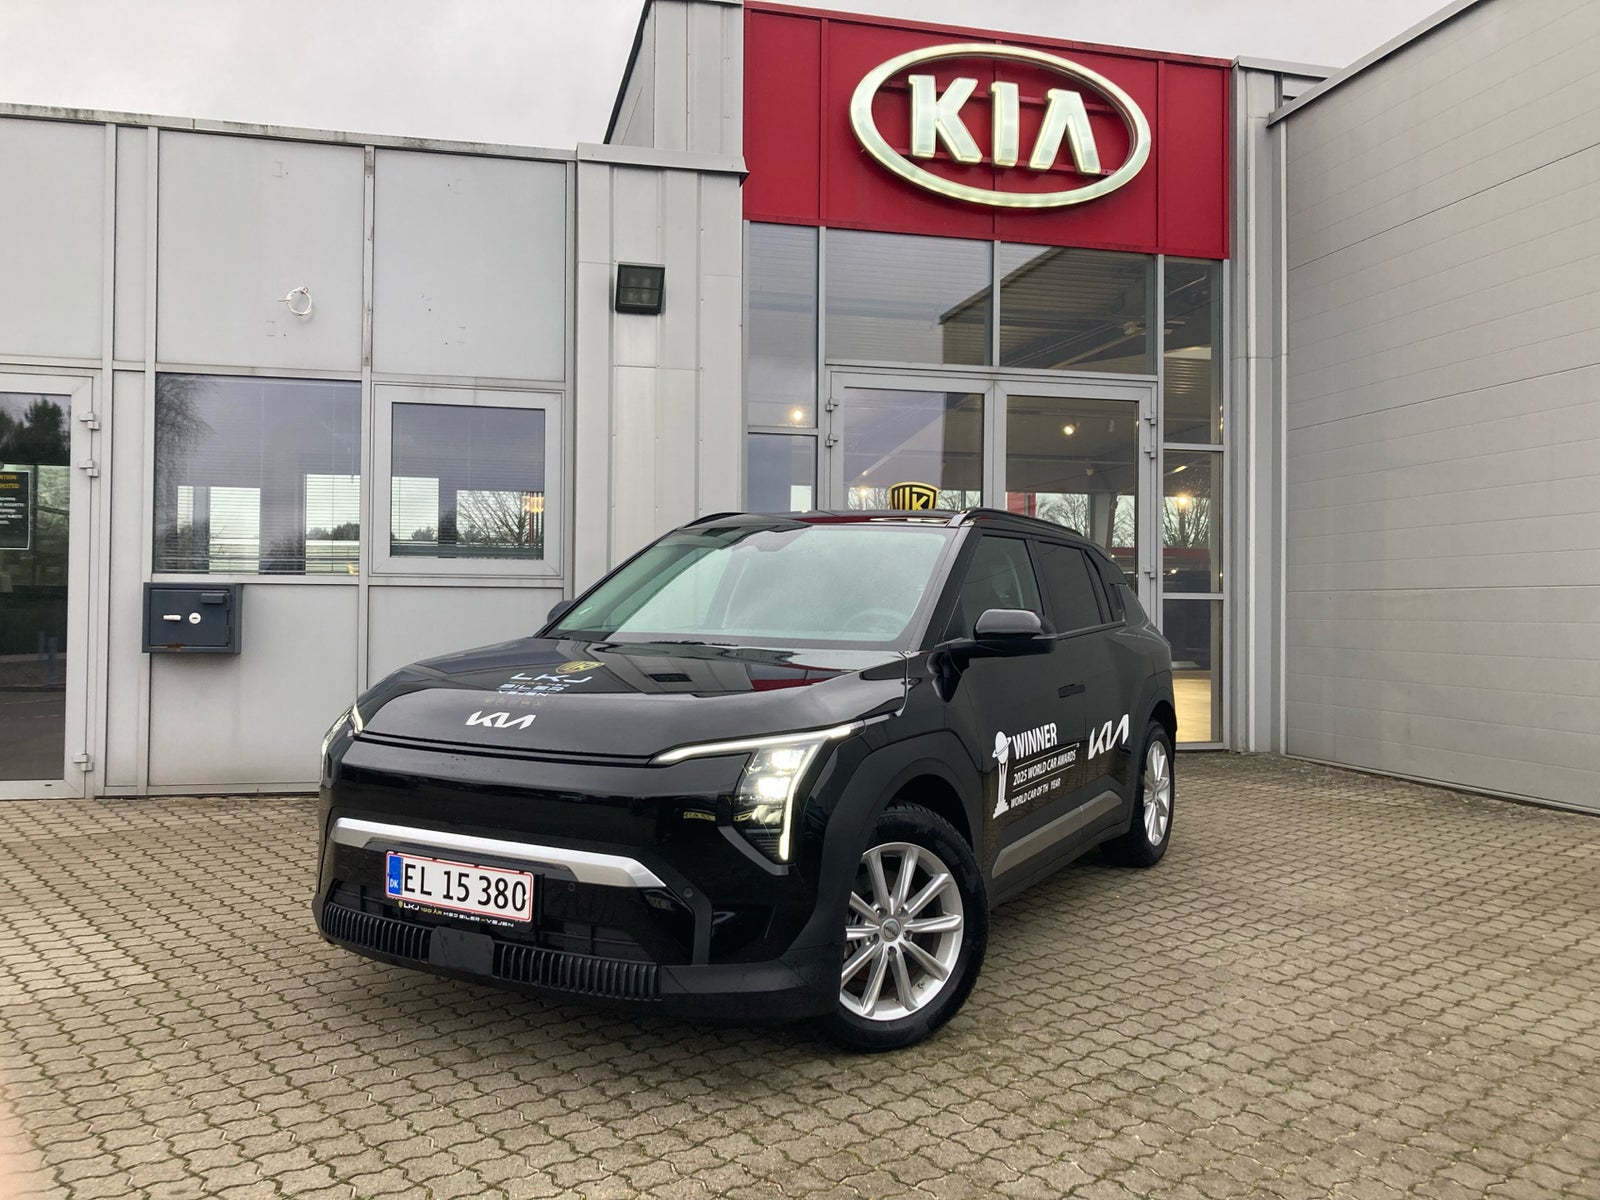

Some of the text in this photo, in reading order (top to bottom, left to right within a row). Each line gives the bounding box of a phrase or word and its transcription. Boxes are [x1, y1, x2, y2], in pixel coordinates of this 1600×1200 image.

[908, 74, 1101, 175] KIA
[510, 673, 592, 683] LKJ
[1012, 722, 1057, 760] WINNER
[1012, 749, 1077, 786] 2025 WORLD CAR AWARDS
[1010, 792, 1028, 808] WORLD
[1027, 787, 1037, 801] CAR
[1036, 785, 1043, 796] OF
[1050, 777, 1061, 790] YEAR
[389, 878, 399, 889] DK
[404, 863, 527, 912] EL 15 380
[403, 902, 420, 911] LKJ
